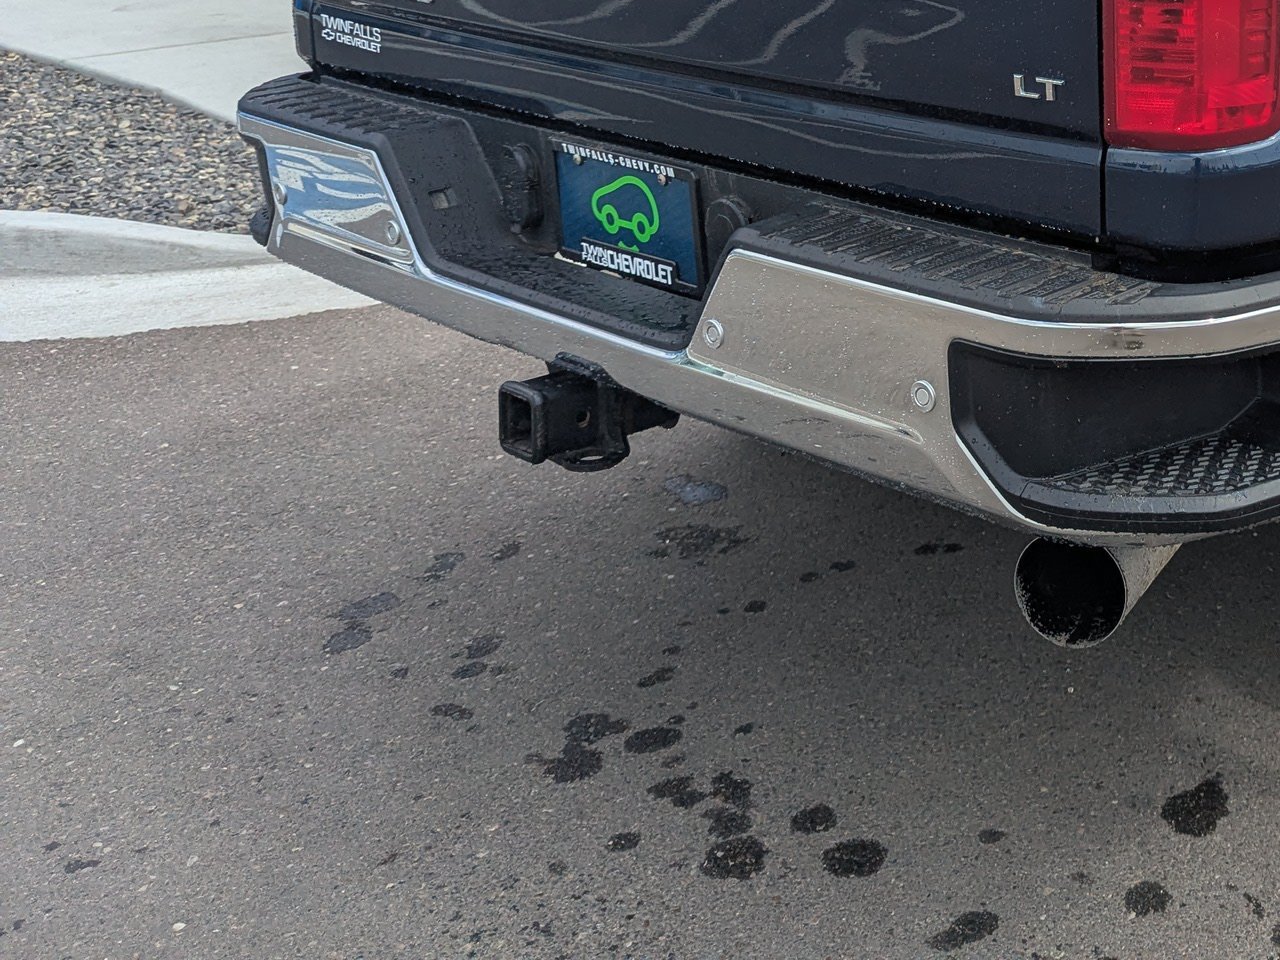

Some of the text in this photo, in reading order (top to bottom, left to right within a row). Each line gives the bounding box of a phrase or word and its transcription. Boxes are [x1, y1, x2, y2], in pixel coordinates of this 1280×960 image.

[320, 14, 382, 42] TWINFALLS
[336, 32, 382, 54] CHEVROLET
[1013, 73, 1065, 102] LT
[580, 242, 608, 259] TWIN
[581, 252, 608, 267] FALLS
[607, 252, 673, 285] CHEVROLET
